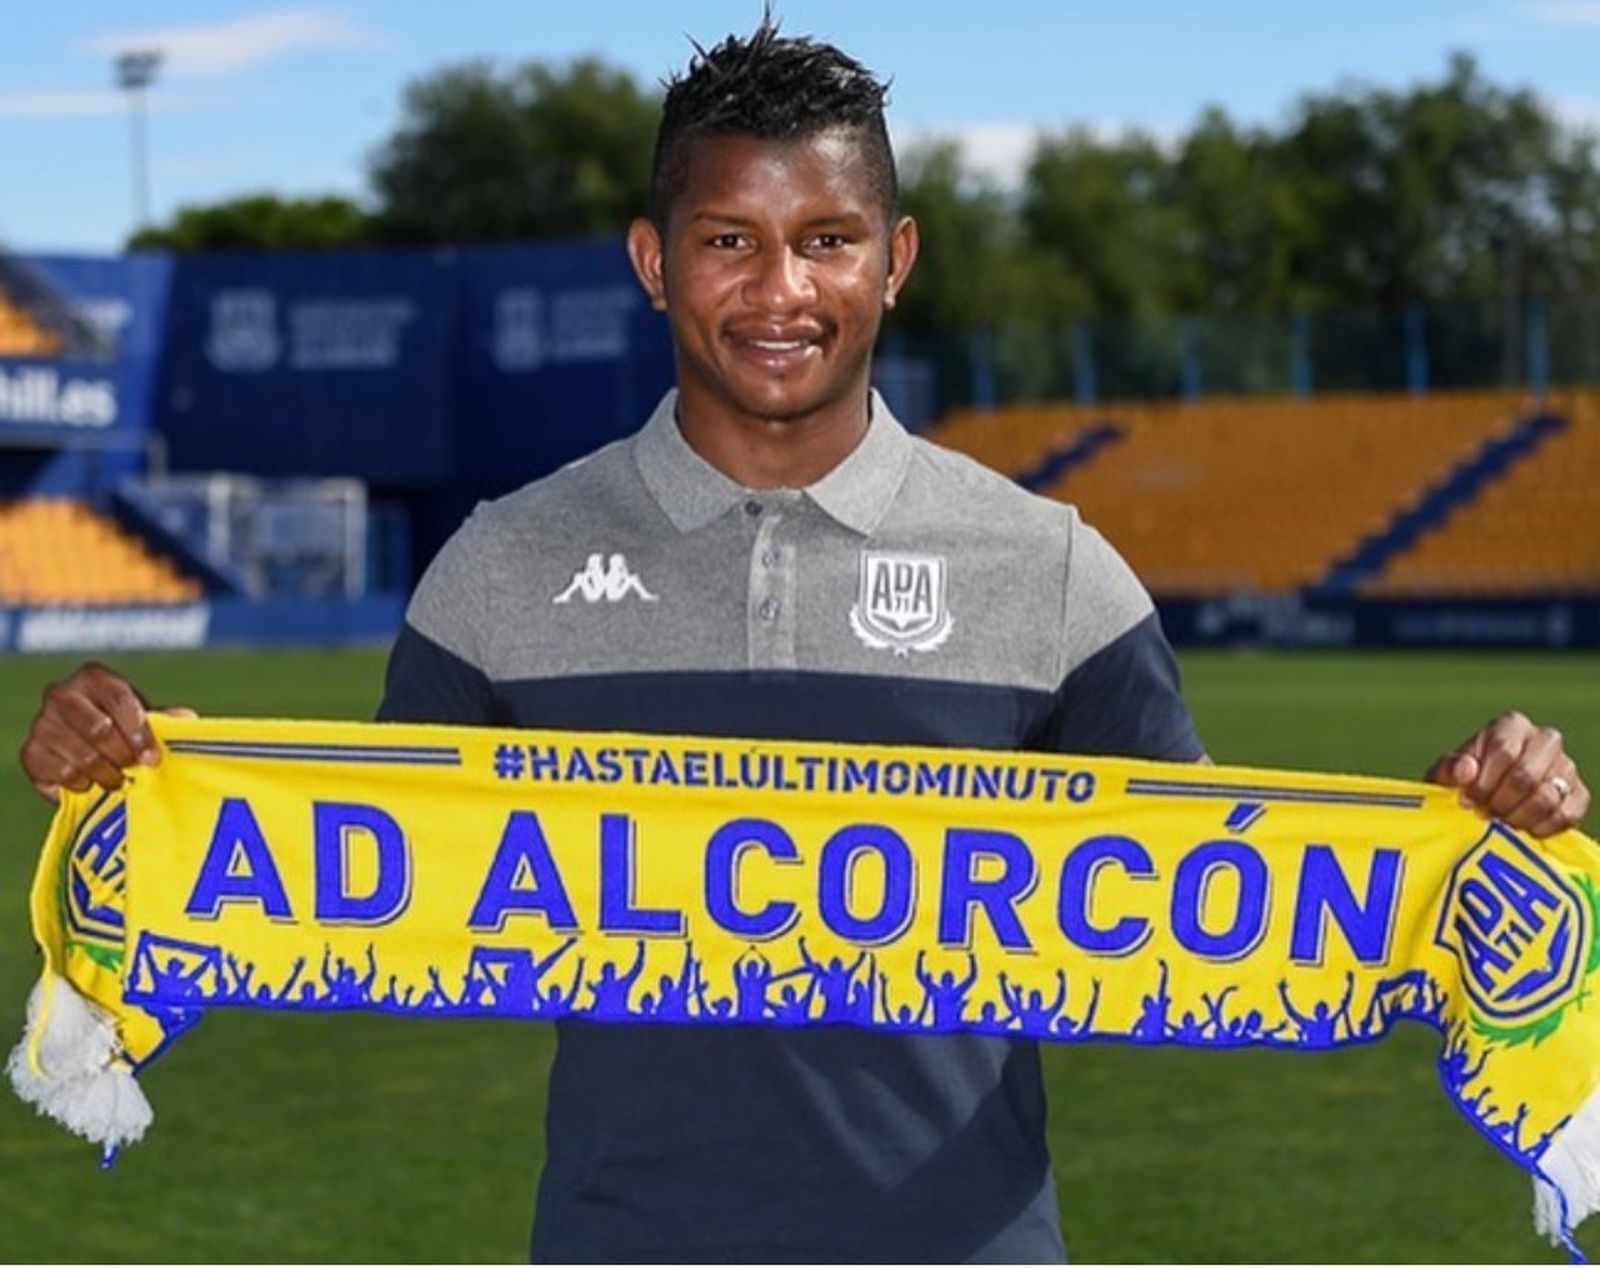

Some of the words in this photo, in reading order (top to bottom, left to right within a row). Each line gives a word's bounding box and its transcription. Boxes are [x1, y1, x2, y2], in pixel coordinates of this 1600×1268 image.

[493, 743, 1097, 803] #HASTAELÚLTIMOMINUTO
[184, 797, 413, 927] AD
[467, 802, 1408, 969] ALCORCÓN
